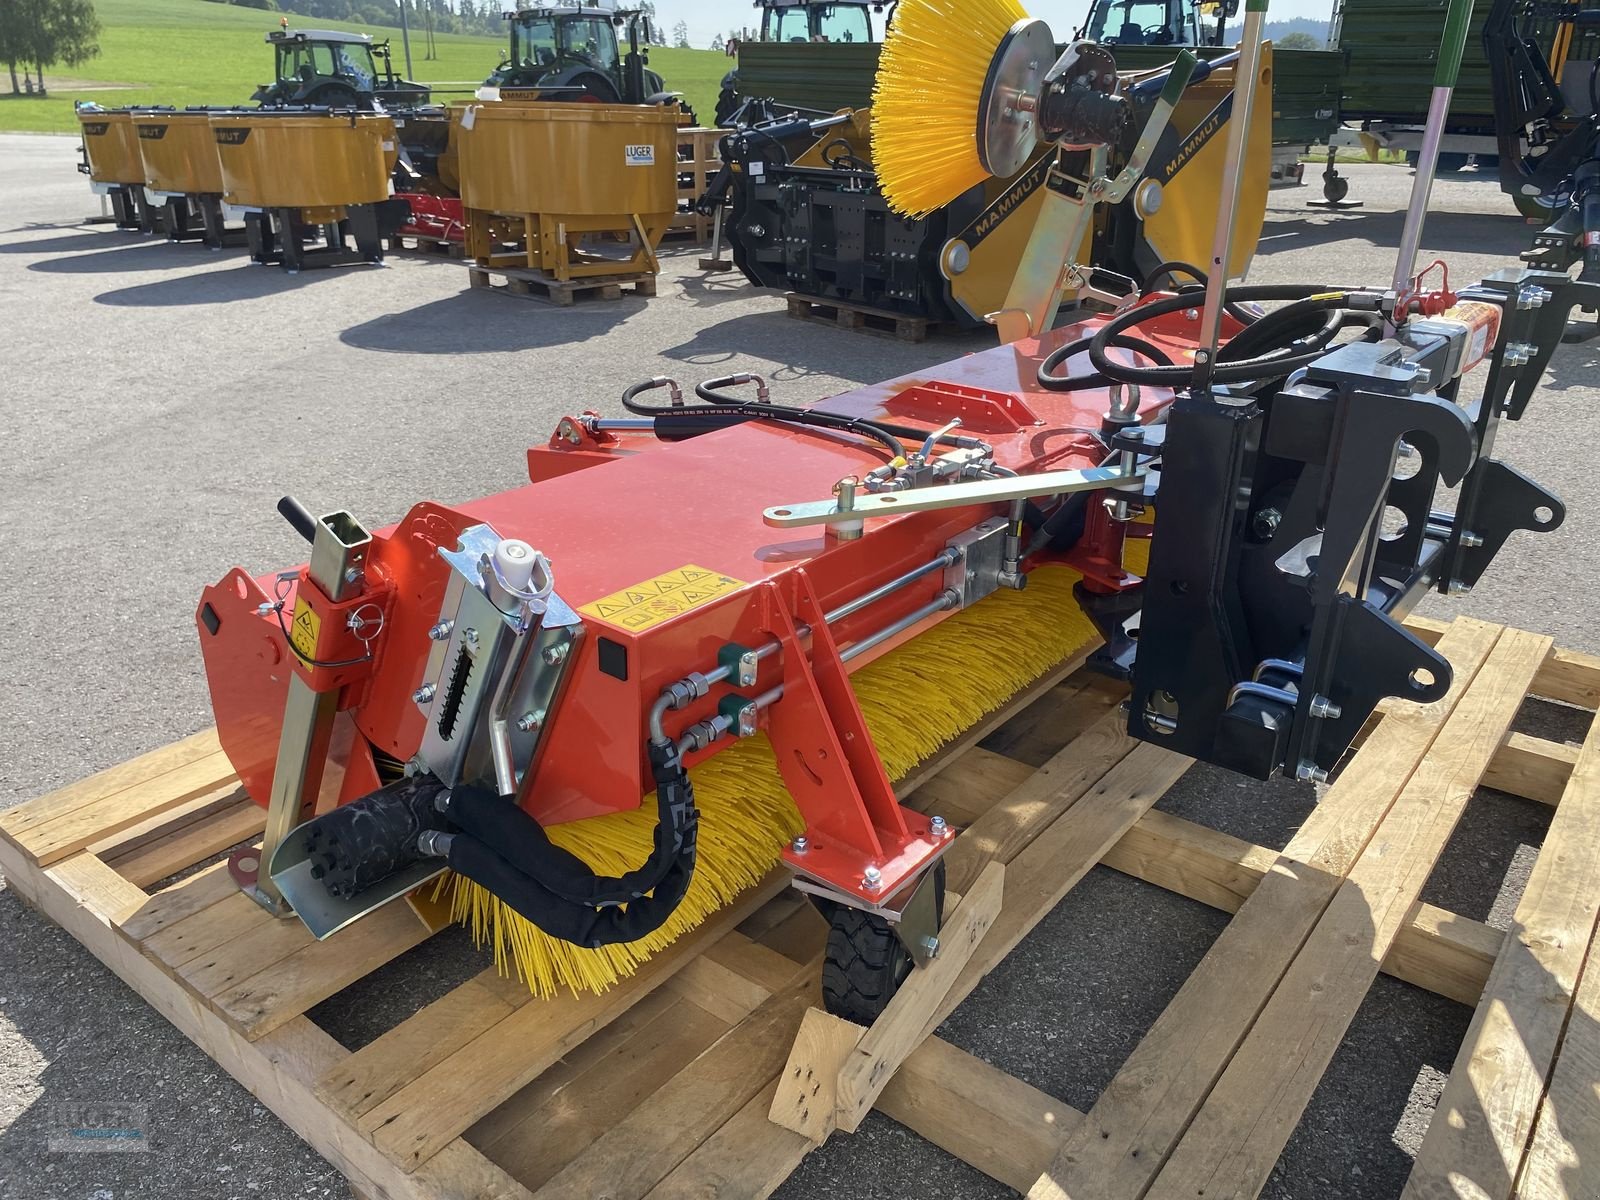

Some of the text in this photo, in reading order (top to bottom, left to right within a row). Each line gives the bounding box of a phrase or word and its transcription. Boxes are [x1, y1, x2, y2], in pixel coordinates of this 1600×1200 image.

[626, 146, 652, 157] LUGER
[1165, 114, 1221, 175] MAMMUT
[975, 172, 1042, 237] MAMMUT
